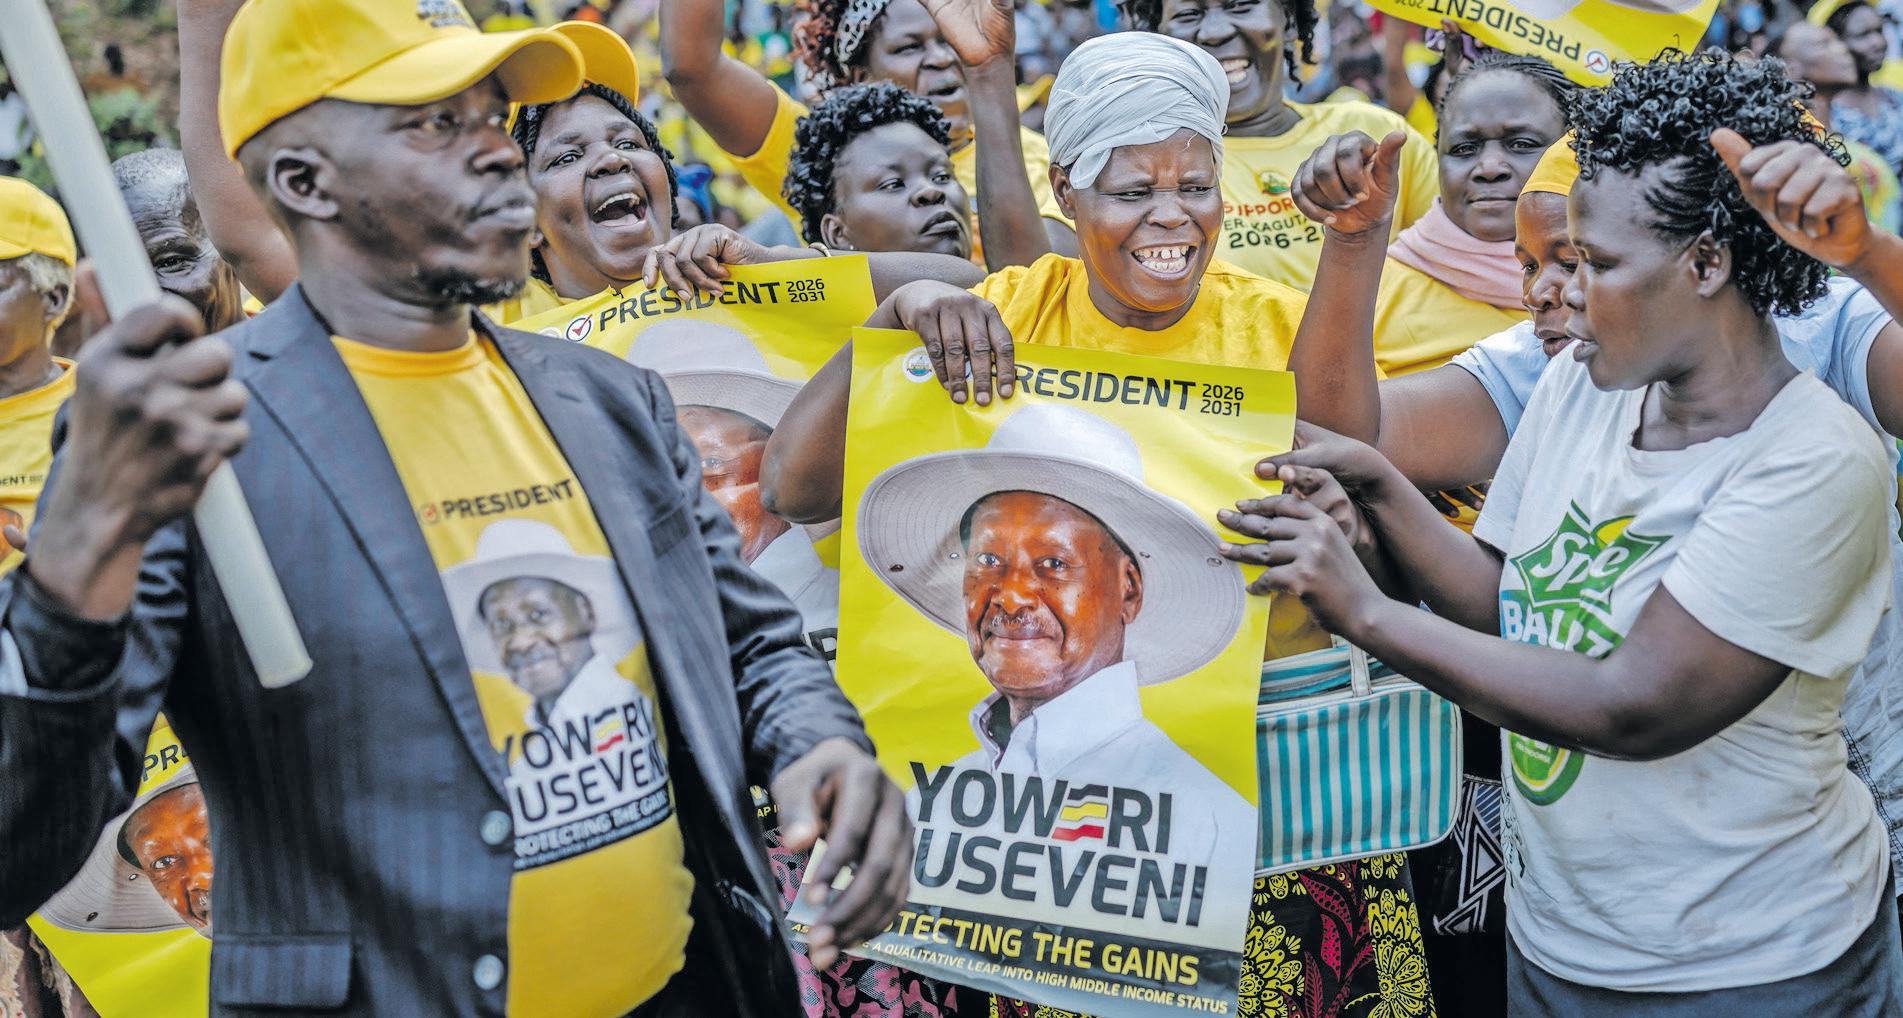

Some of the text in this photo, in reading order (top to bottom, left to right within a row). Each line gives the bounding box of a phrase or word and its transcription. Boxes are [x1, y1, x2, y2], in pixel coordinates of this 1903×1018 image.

[1426, 0, 1581, 61] PRESIDENT
[786, 278, 825, 293] 2026
[789, 291, 826, 303] 2031
[1014, 363, 1245, 411] RESIDENT 2026
[1200, 400, 1241, 417] 2031
[442, 478, 577, 519] PRESIDENT
[517, 739, 665, 822] USEVEN
[909, 761, 1173, 854] YOWERI
[913, 828, 1208, 928] USEVENI
[884, 911, 1199, 986] TECTING THE GAINS
[884, 943, 965, 968] QUALITATIVE
[967, 960, 1001, 977] LEAP
[1003, 965, 1033, 982] INTO
[1036, 971, 1068, 988] HIGH
[1070, 976, 1120, 996] MIDDLE
[1123, 985, 1174, 1006] INCOME
[1176, 994, 1228, 1015] STATUS
